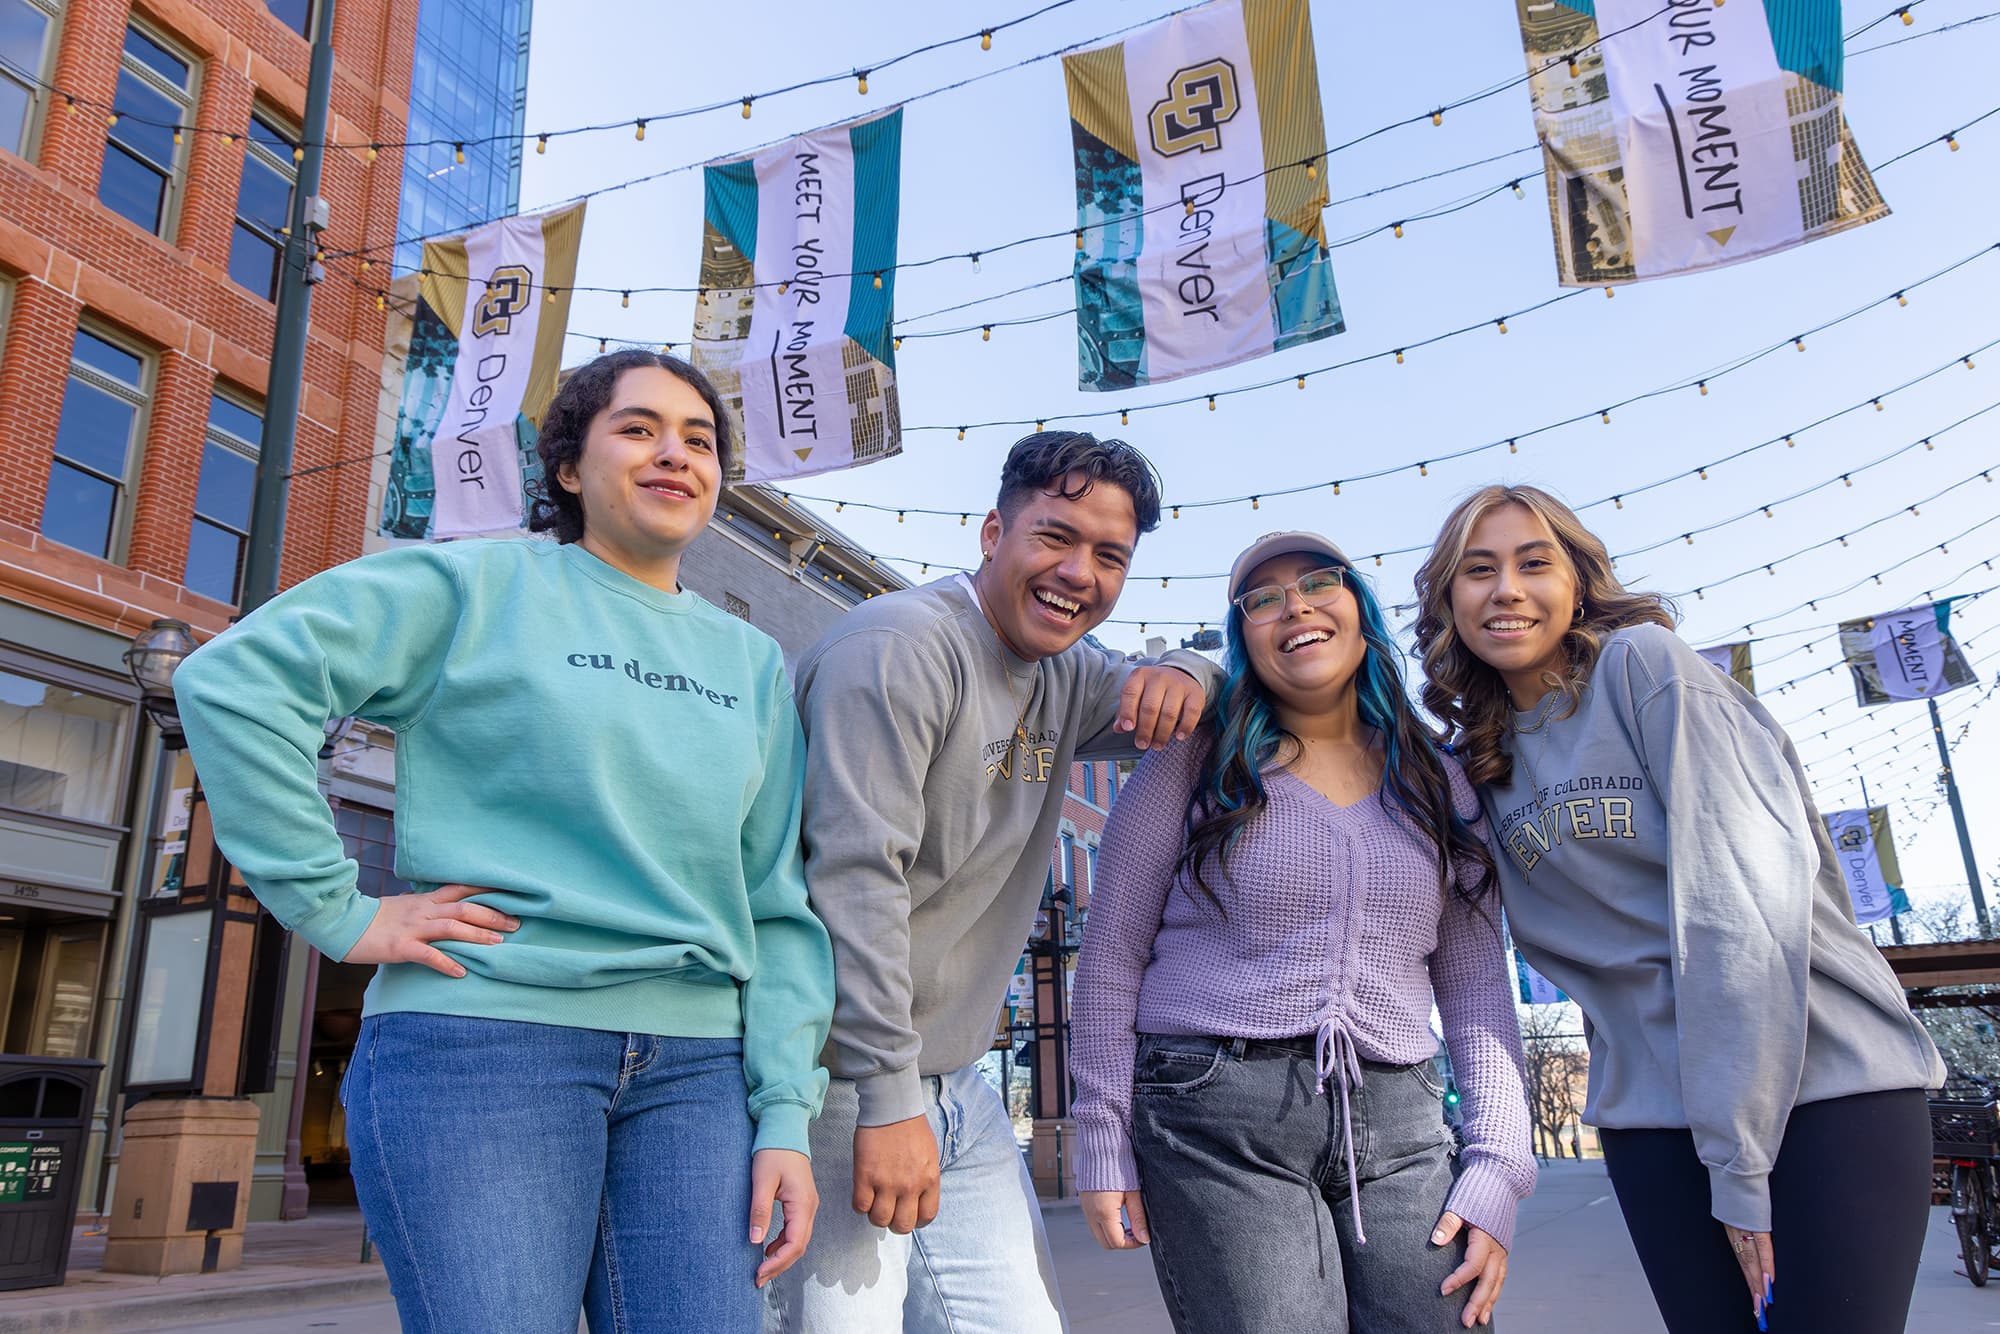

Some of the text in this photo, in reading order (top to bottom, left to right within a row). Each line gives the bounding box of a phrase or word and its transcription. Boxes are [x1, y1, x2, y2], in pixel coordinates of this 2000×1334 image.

[1678, 65, 1744, 215] MOMENT
[1175, 172, 1225, 322] Denver
[782, 153, 825, 441] MEET YOUR MOMENT
[457, 354, 507, 490] Denver
[567, 653, 738, 710] cu denver
[1897, 620, 1929, 683] MOMENT
[1554, 776, 1643, 796] COLORADO
[1507, 797, 1636, 874] ENVER
[1849, 858, 1875, 908] Denver
